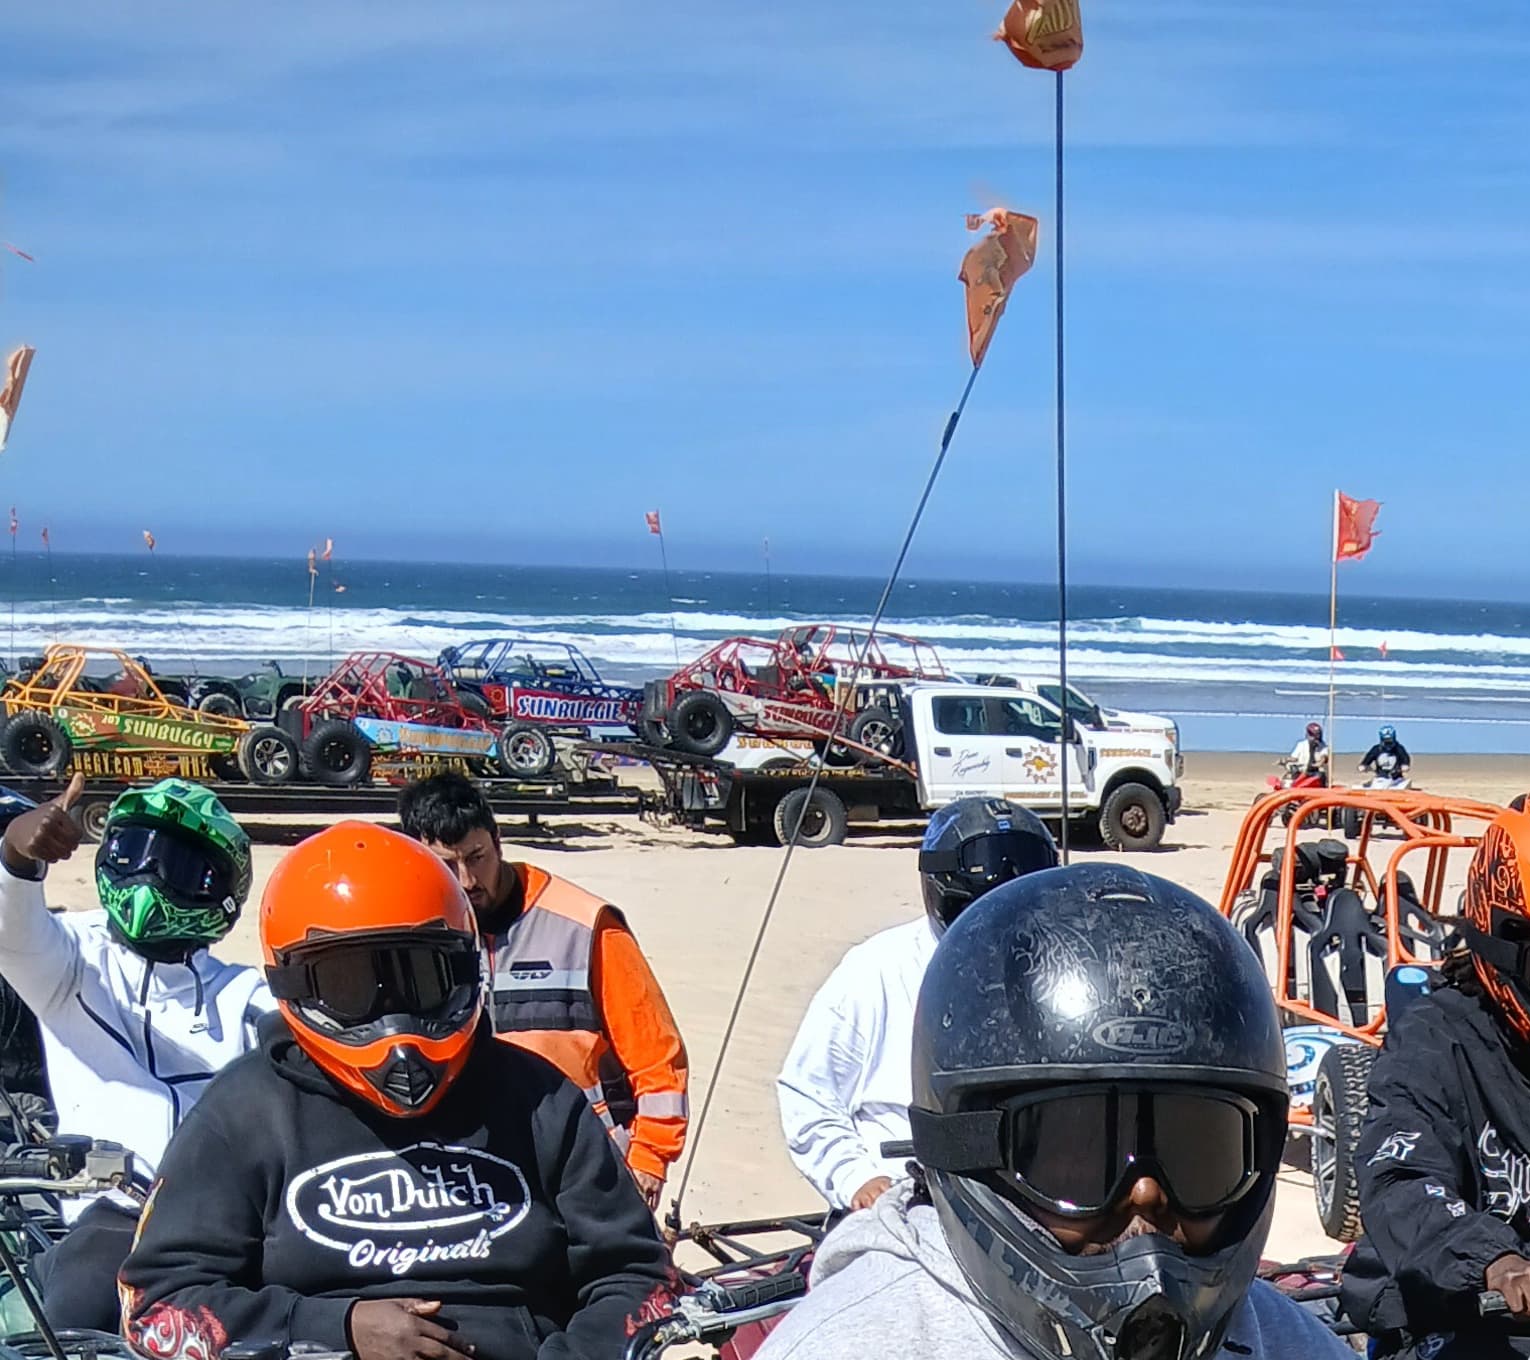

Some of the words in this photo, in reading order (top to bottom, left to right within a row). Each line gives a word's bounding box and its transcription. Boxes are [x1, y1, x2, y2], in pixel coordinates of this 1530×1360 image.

[517, 694, 621, 721] SUNBUGGIE
[123, 718, 214, 749] SUNBUGGY
[318, 1174, 390, 1218] Von
[386, 1163, 500, 1214] Dutch
[348, 1228, 493, 1275] Originals
